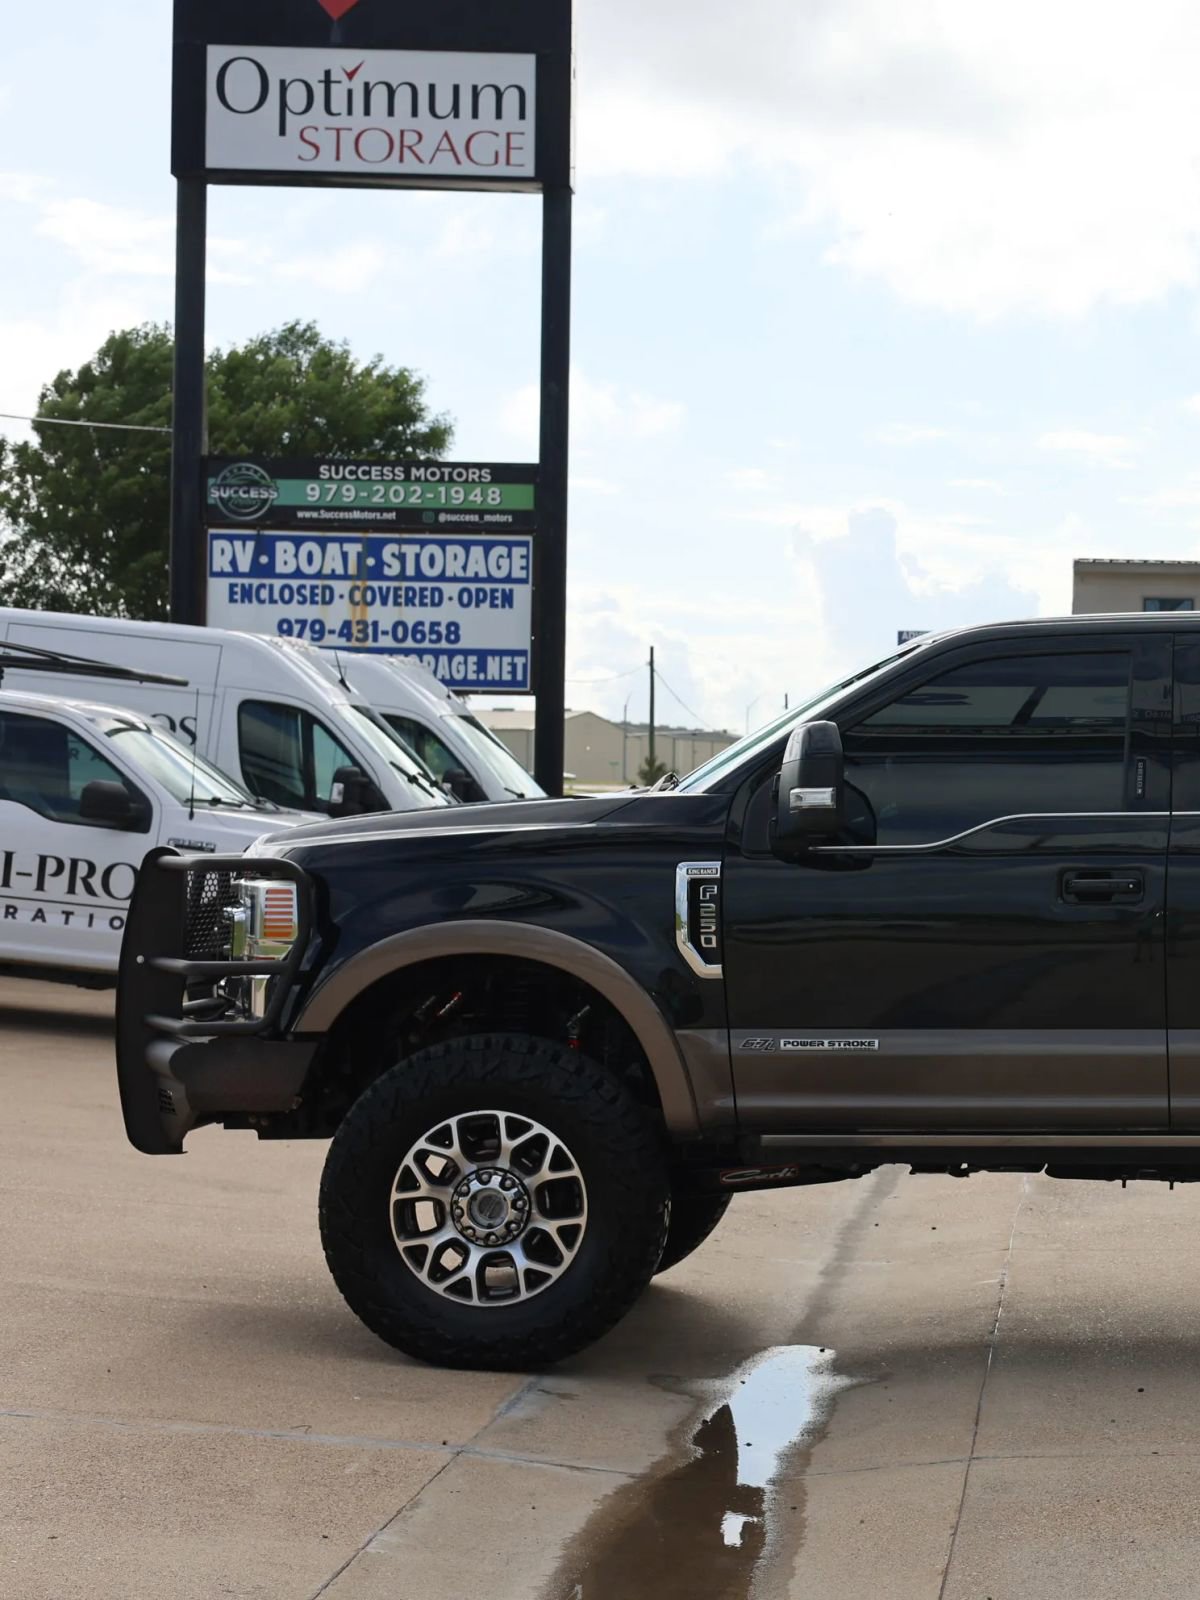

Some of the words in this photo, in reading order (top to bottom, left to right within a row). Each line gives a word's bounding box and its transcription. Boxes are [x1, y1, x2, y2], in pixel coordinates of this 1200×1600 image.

[216, 56, 527, 137] Optimum
[297, 125, 526, 168] STORAGE
[319, 465, 405, 481] SUCCESS
[411, 467, 492, 483] MOTORS
[210, 486, 278, 499] SUCCESS
[306, 483, 502, 505] 979-202-1948
[296, 509, 396, 520] www.SuccessMotors.net
[438, 512, 513, 524] @success_motors
[211, 539, 255, 573] RV
[274, 541, 363, 575] BOAT
[381, 543, 528, 579] STORAGE
[228, 583, 335, 606] ENCLOSED
[349, 584, 444, 608] COVERED
[457, 587, 514, 609] OPEN
[277, 618, 461, 645] 979-431-0658
